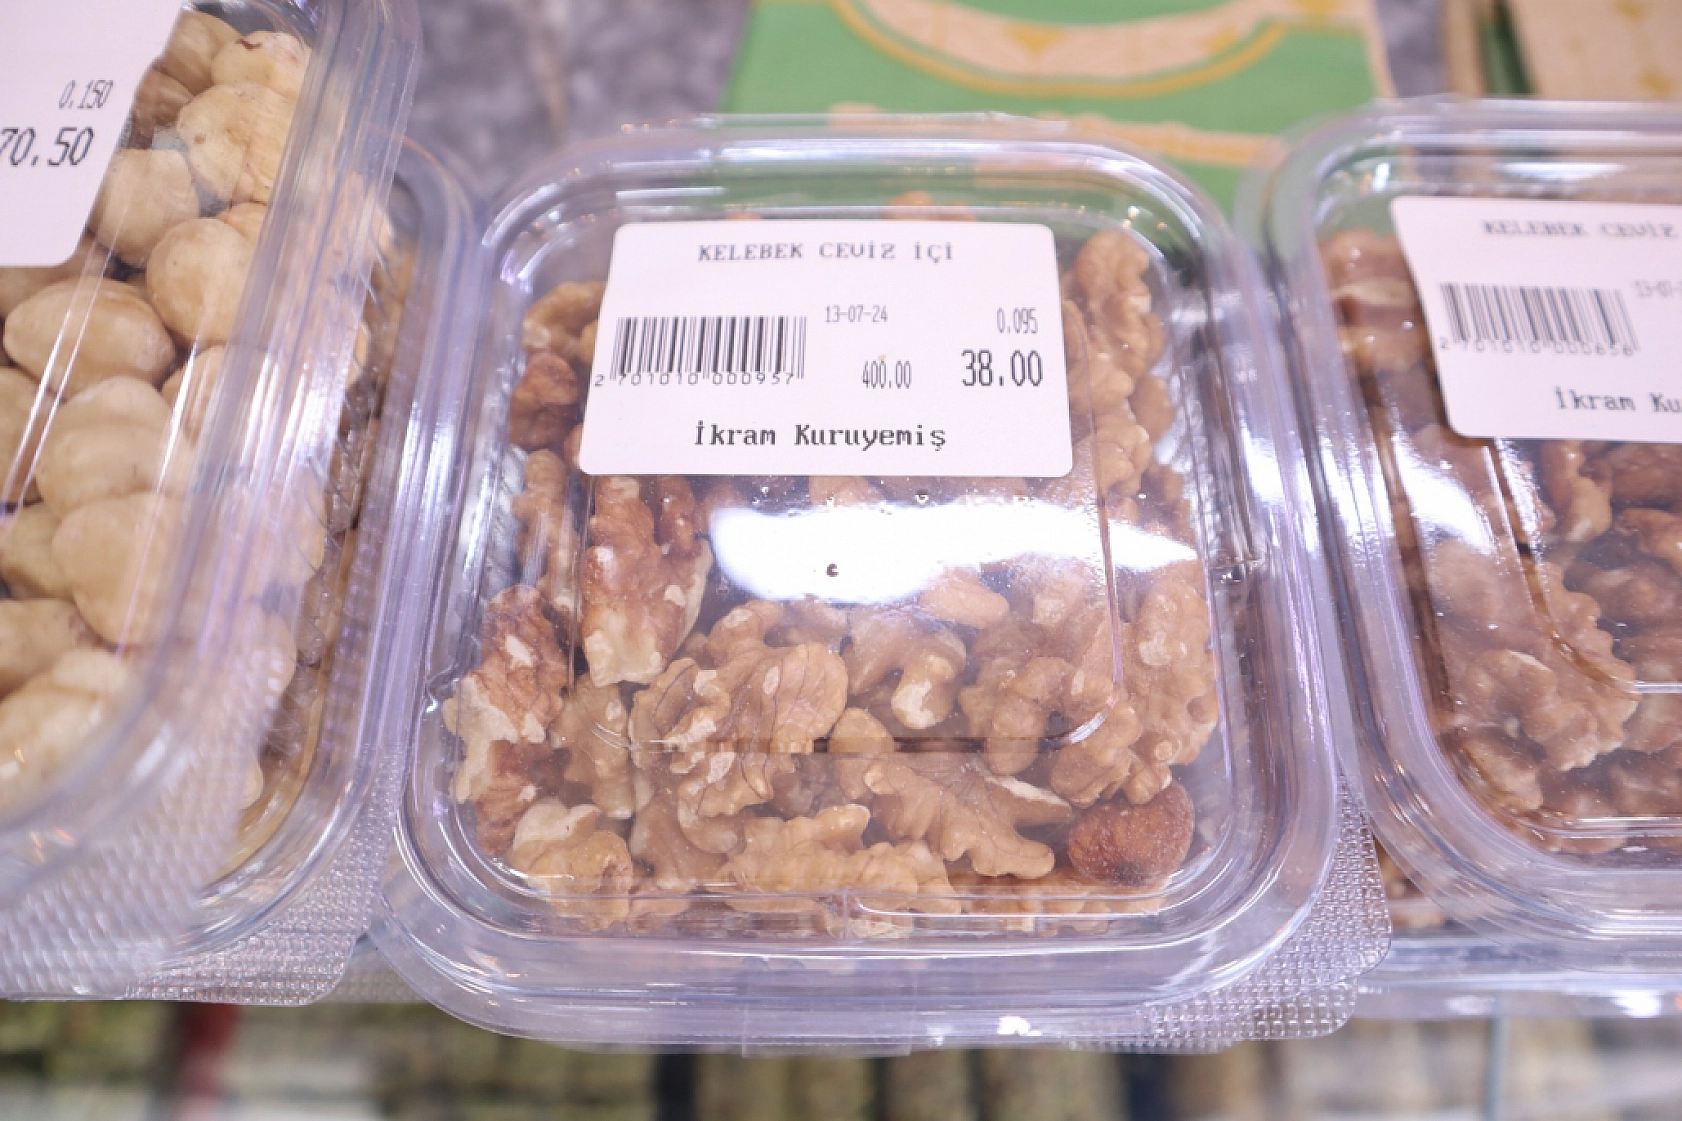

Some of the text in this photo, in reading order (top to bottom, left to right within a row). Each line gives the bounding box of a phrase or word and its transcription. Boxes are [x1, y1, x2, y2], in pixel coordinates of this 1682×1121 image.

[59, 79, 114, 109] 0.150
[0, 126, 95, 168] 70.50
[698, 242, 804, 262] KELEBEK
[914, 241, 954, 263] İÇİ
[824, 305, 889, 324] 13-07-24
[996, 307, 1039, 335] 0.095
[861, 360, 912, 390] 400.00
[961, 349, 1043, 388] 38.00
[694, 420, 947, 452] İkram Kuruyemiş
